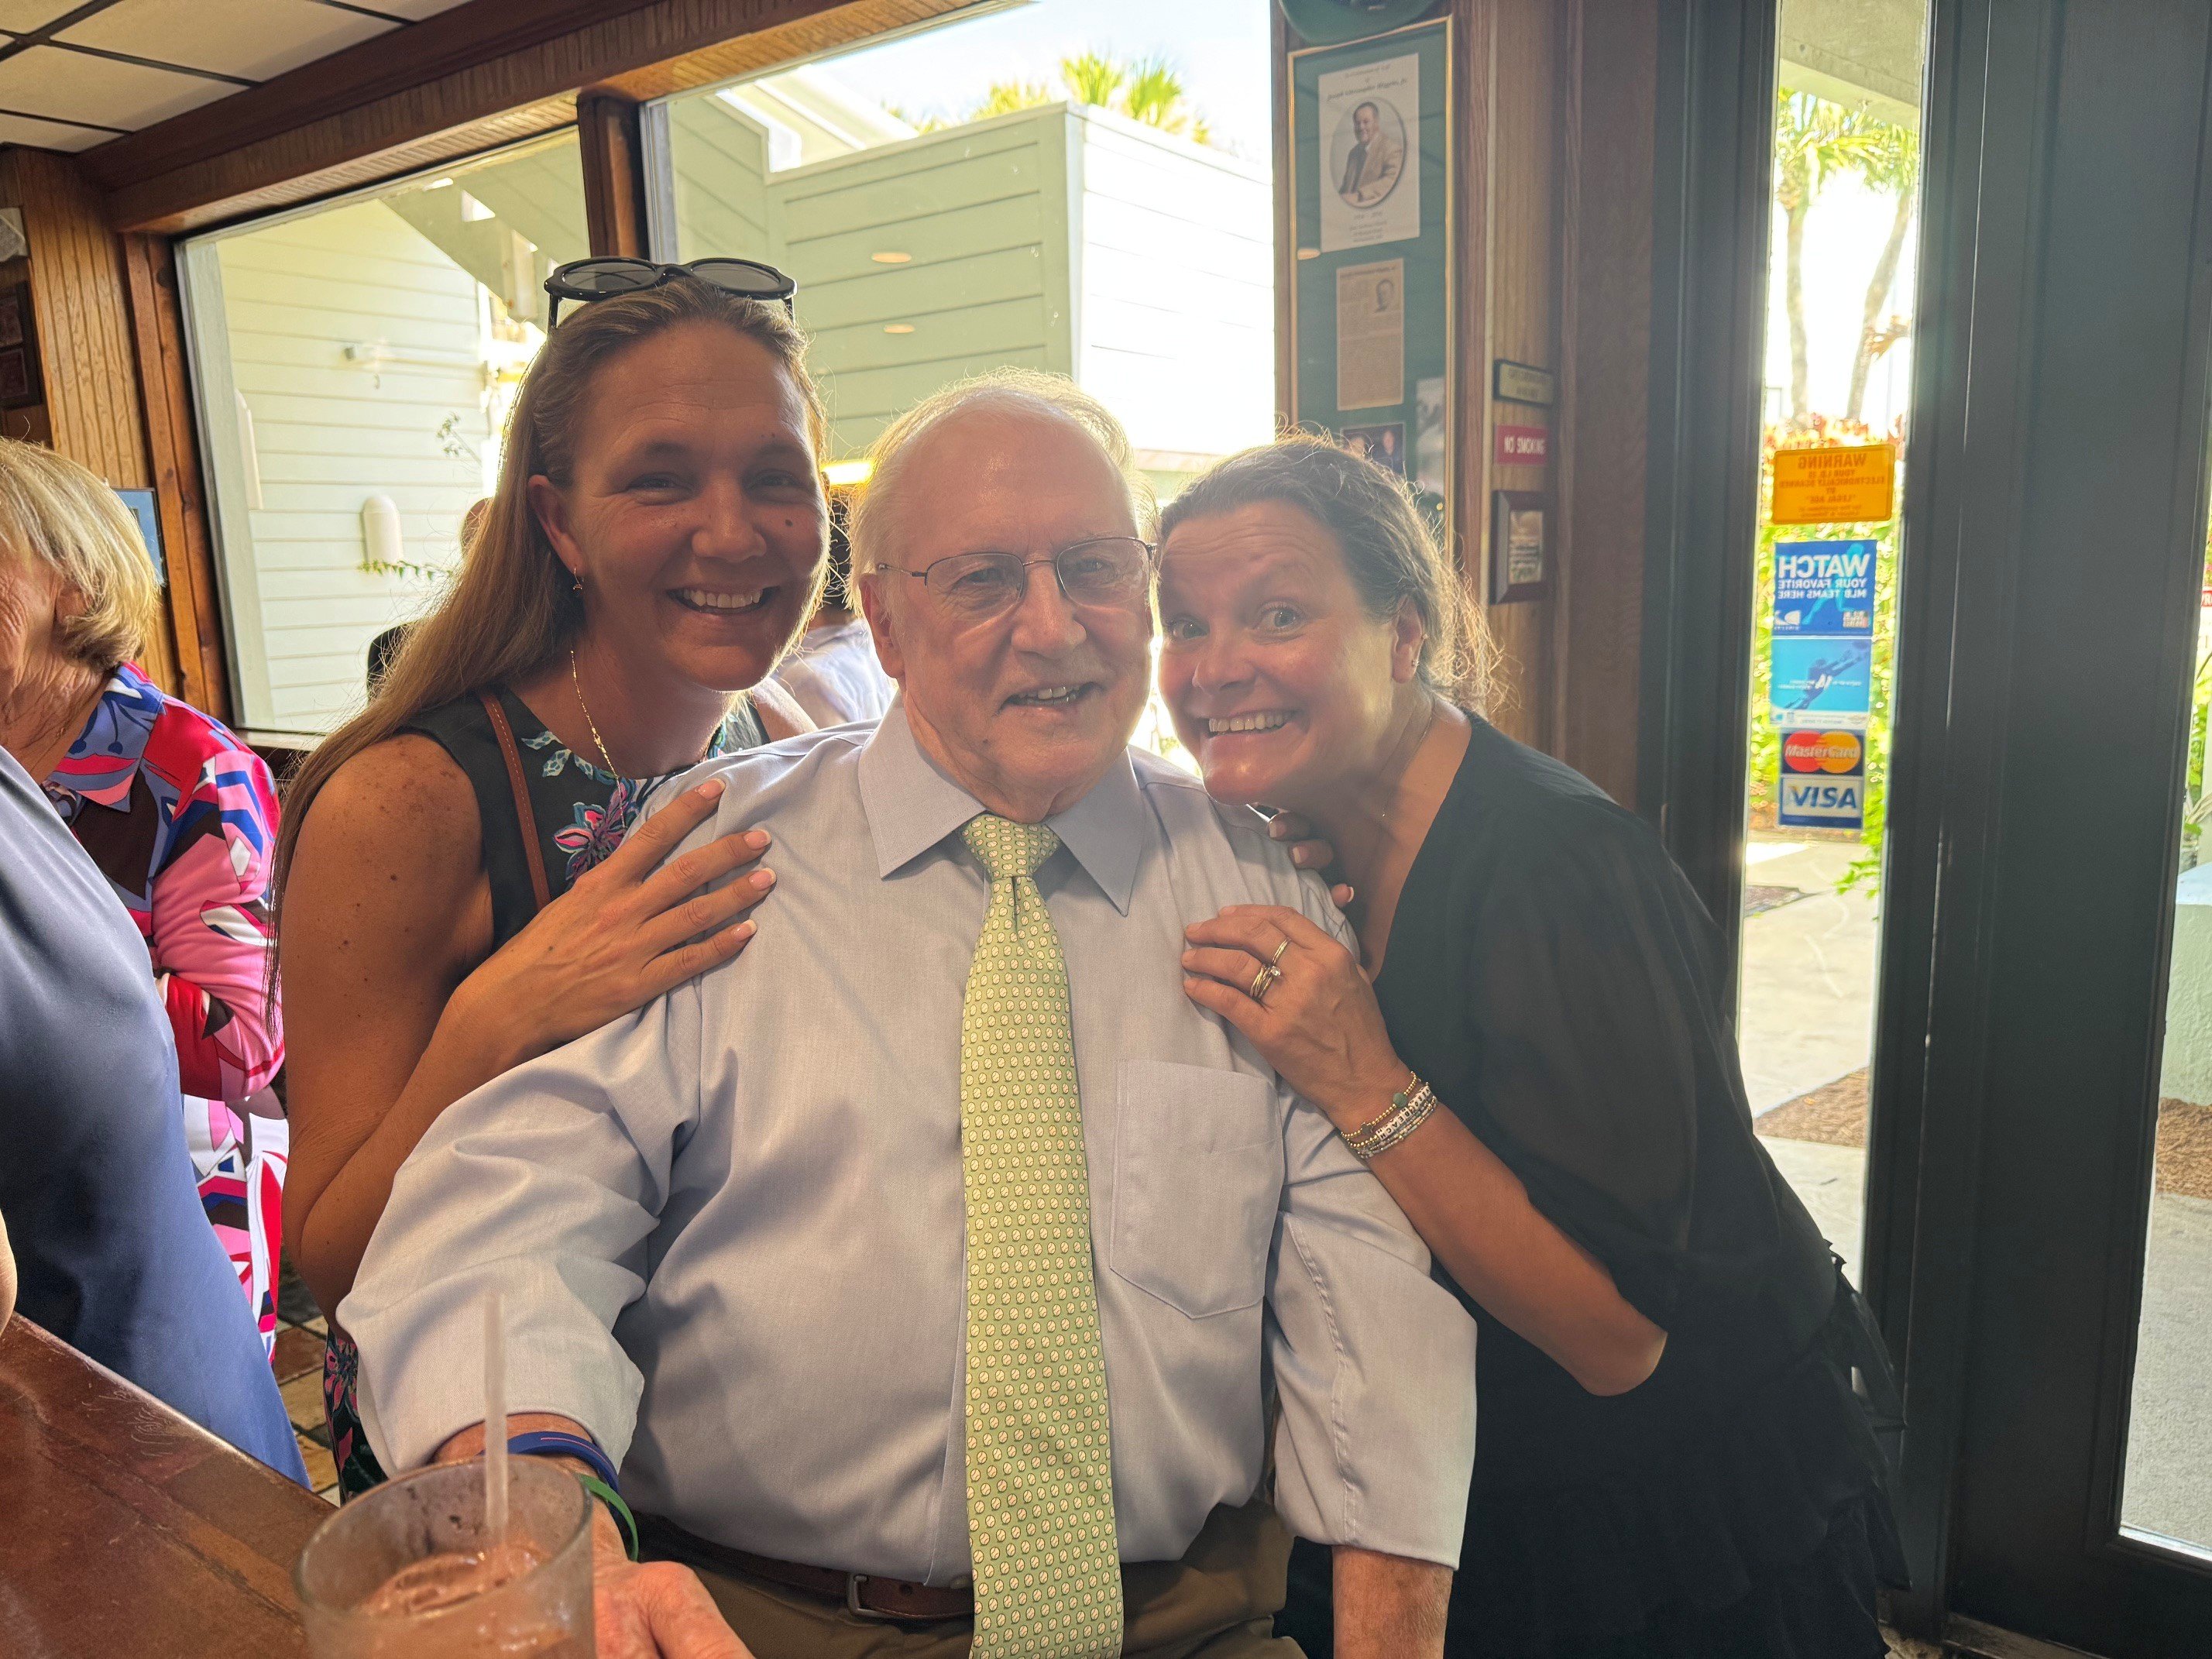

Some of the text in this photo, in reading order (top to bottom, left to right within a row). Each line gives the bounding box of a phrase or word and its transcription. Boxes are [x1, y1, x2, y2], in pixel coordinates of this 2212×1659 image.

[1504, 435, 1546, 455] NO SMOKING
[1784, 744, 1859, 759] MasterCard
[1789, 785, 1857, 809] VISA
[1379, 1111, 1410, 1139] BEACH
